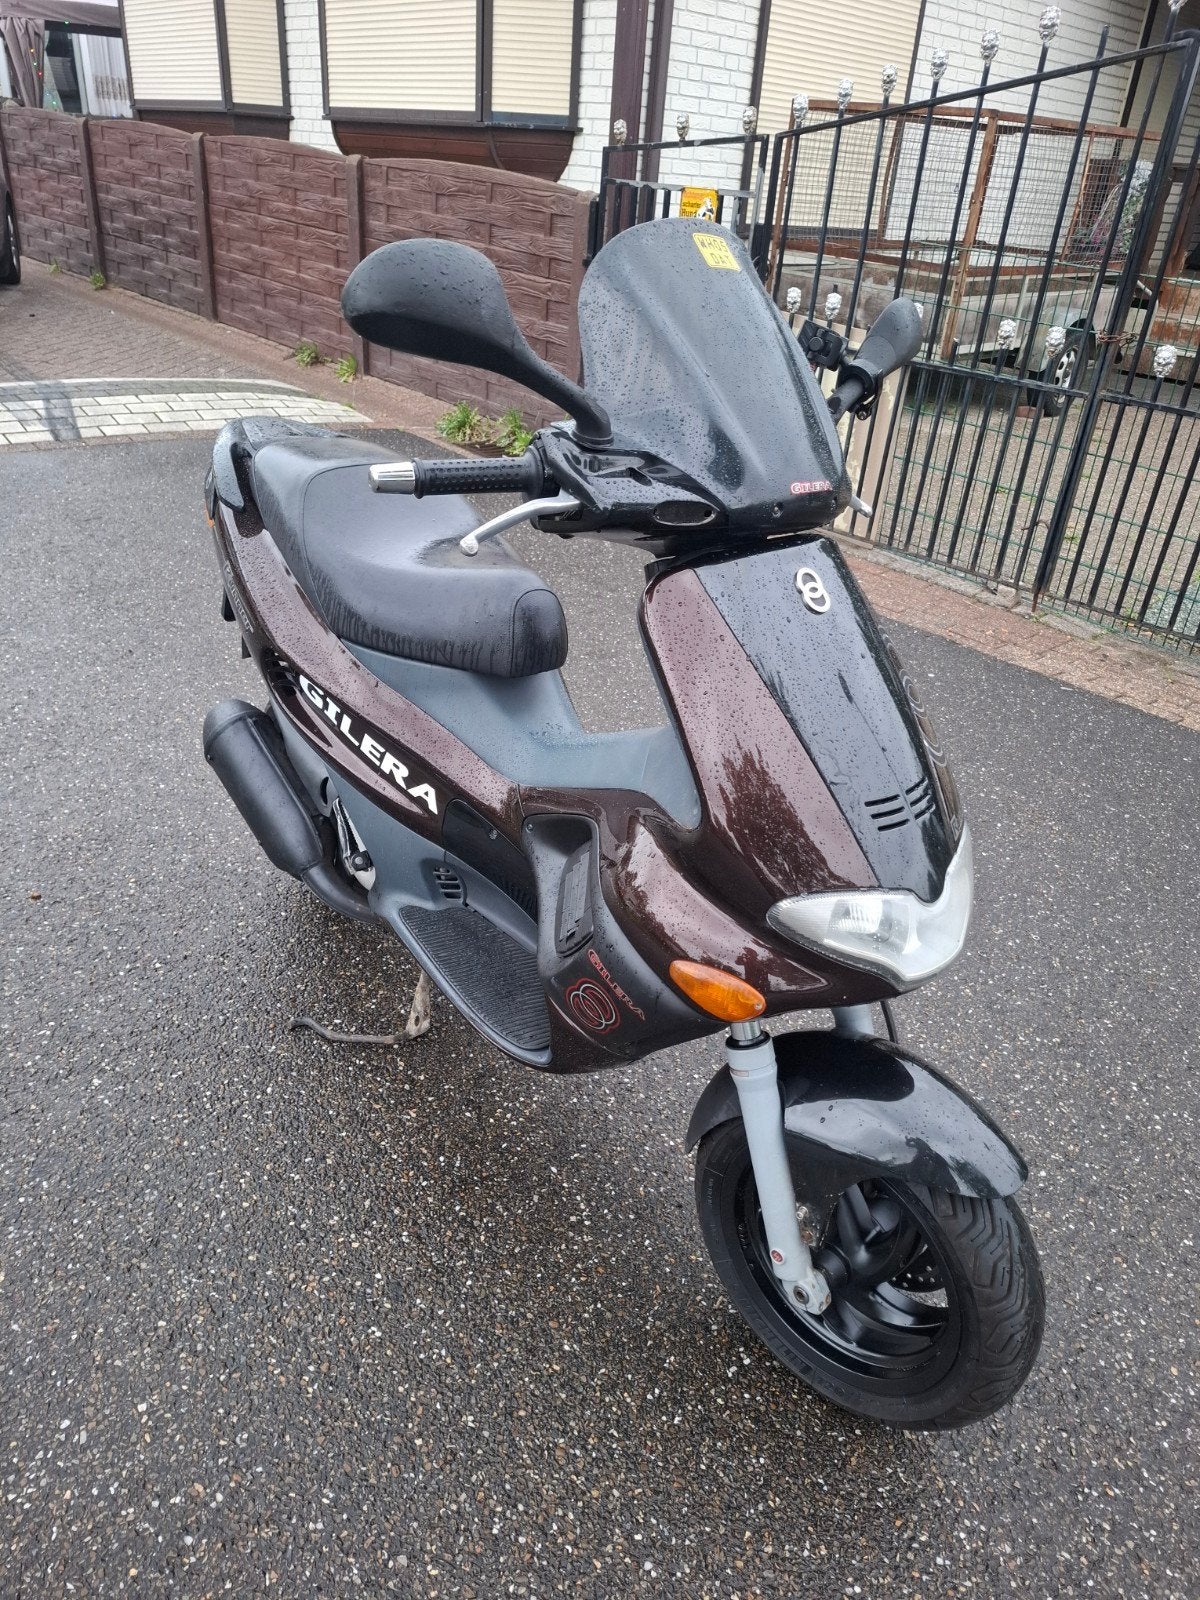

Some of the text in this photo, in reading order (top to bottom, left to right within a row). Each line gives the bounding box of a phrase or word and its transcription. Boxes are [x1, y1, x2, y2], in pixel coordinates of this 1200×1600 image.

[790, 481, 833, 495] GILERA
[299, 674, 438, 815] GILERA
[587, 949, 645, 1021] GILERA
